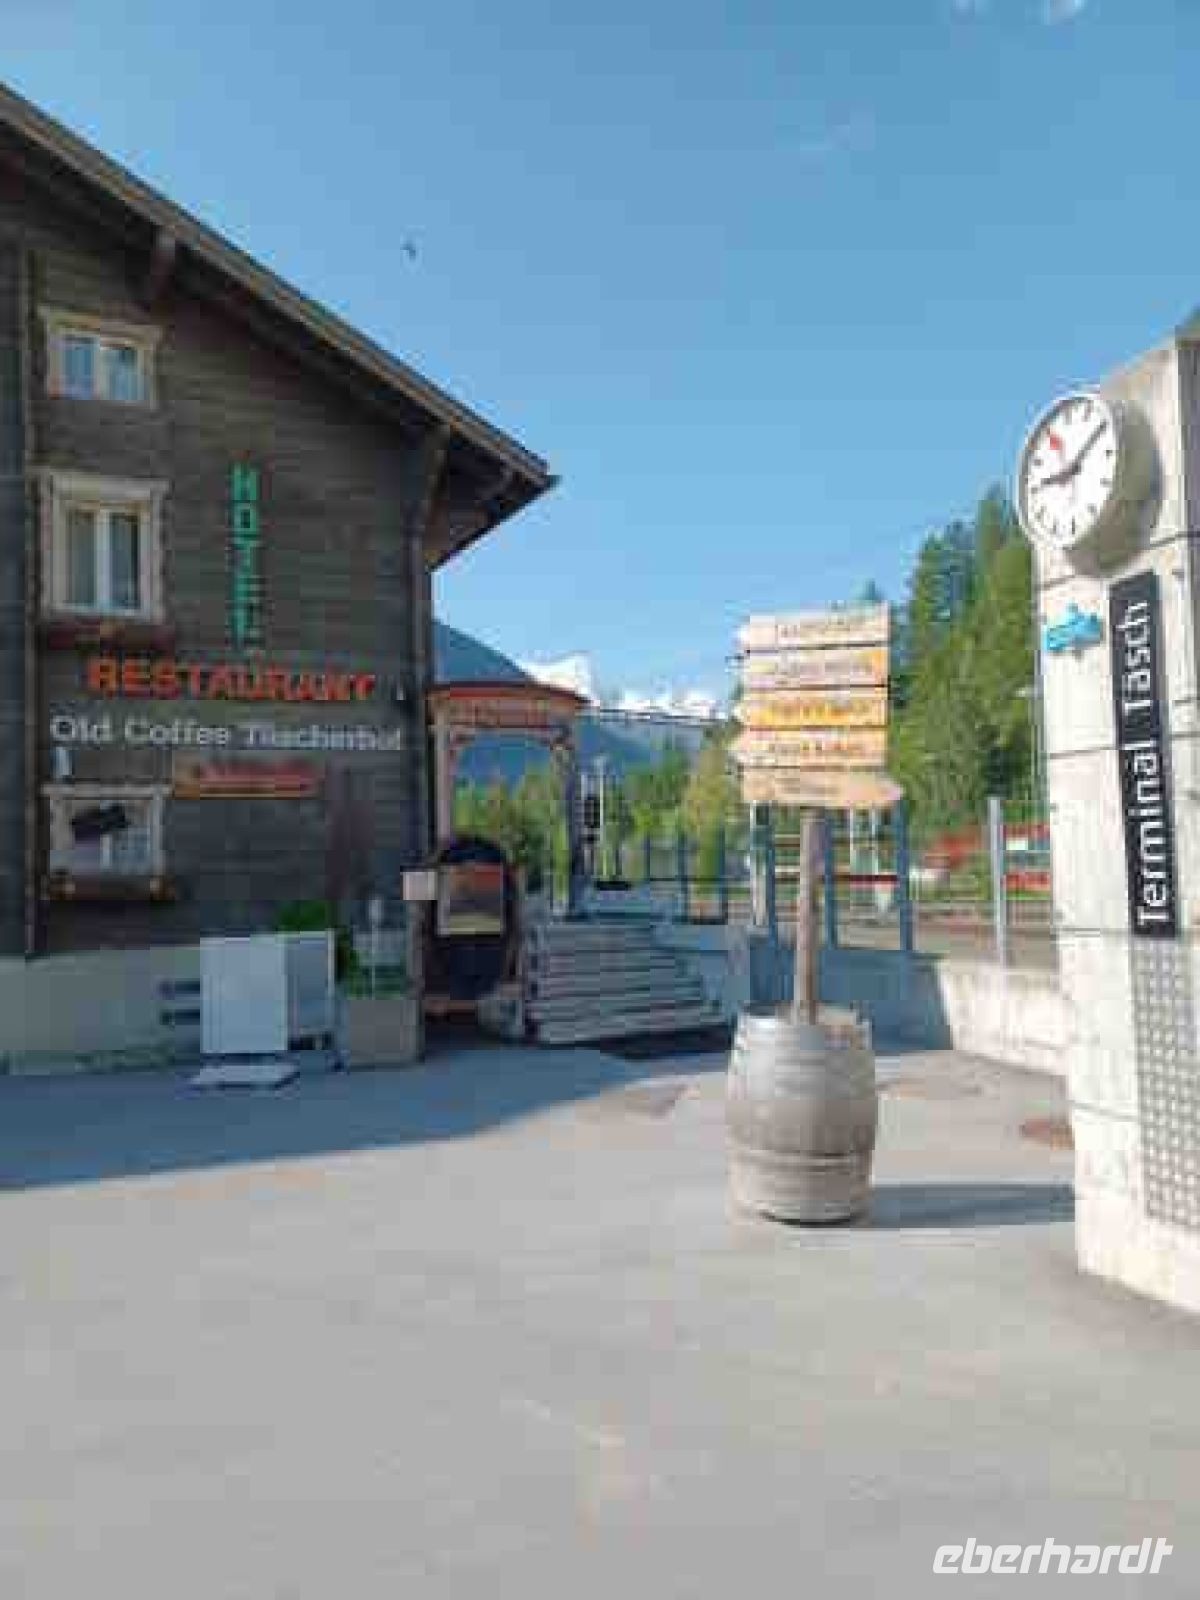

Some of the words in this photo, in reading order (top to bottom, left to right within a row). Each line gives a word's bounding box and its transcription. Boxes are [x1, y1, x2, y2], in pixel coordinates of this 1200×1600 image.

[229, 462, 266, 648] HOTEL
[50, 714, 112, 744] Old
[124, 716, 230, 746] Coffee
[87, 657, 376, 701] RESTAURANT
[1122, 739, 1170, 926] Terminal
